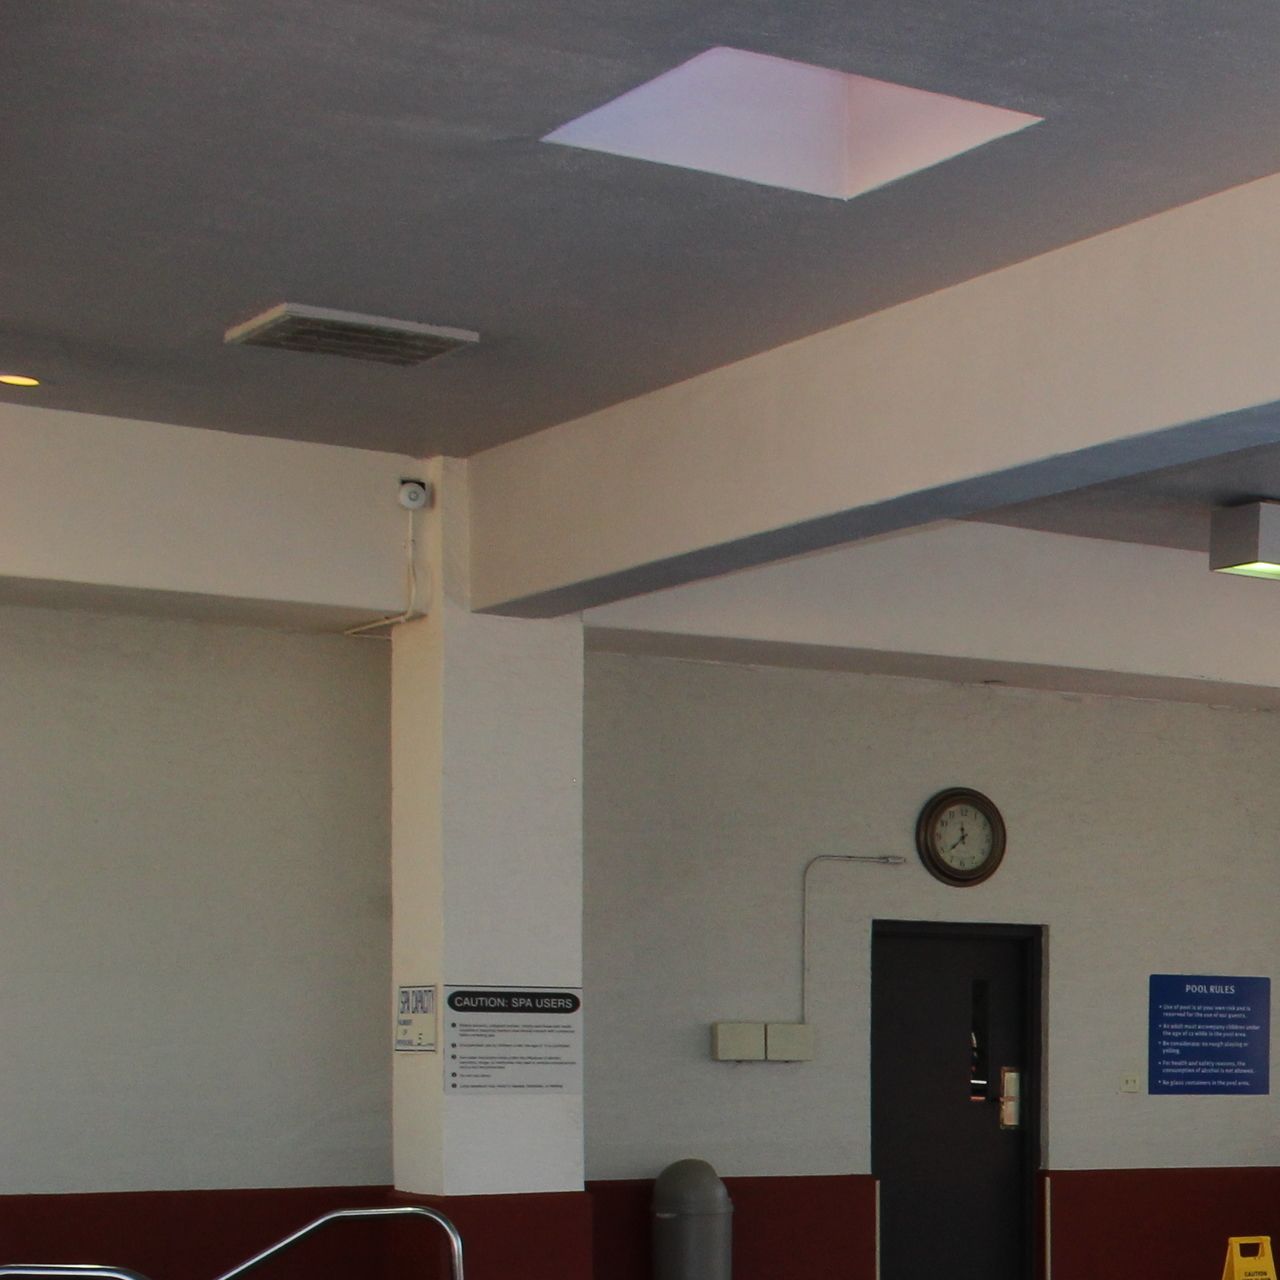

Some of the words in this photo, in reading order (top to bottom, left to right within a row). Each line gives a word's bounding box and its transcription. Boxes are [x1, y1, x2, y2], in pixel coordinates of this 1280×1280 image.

[1185, 984, 1208, 993] POOL
[1209, 984, 1235, 994] RULES
[454, 996, 509, 1008] CAUTION:
[511, 997, 533, 1008] SPA
[535, 997, 573, 1009] USERS
